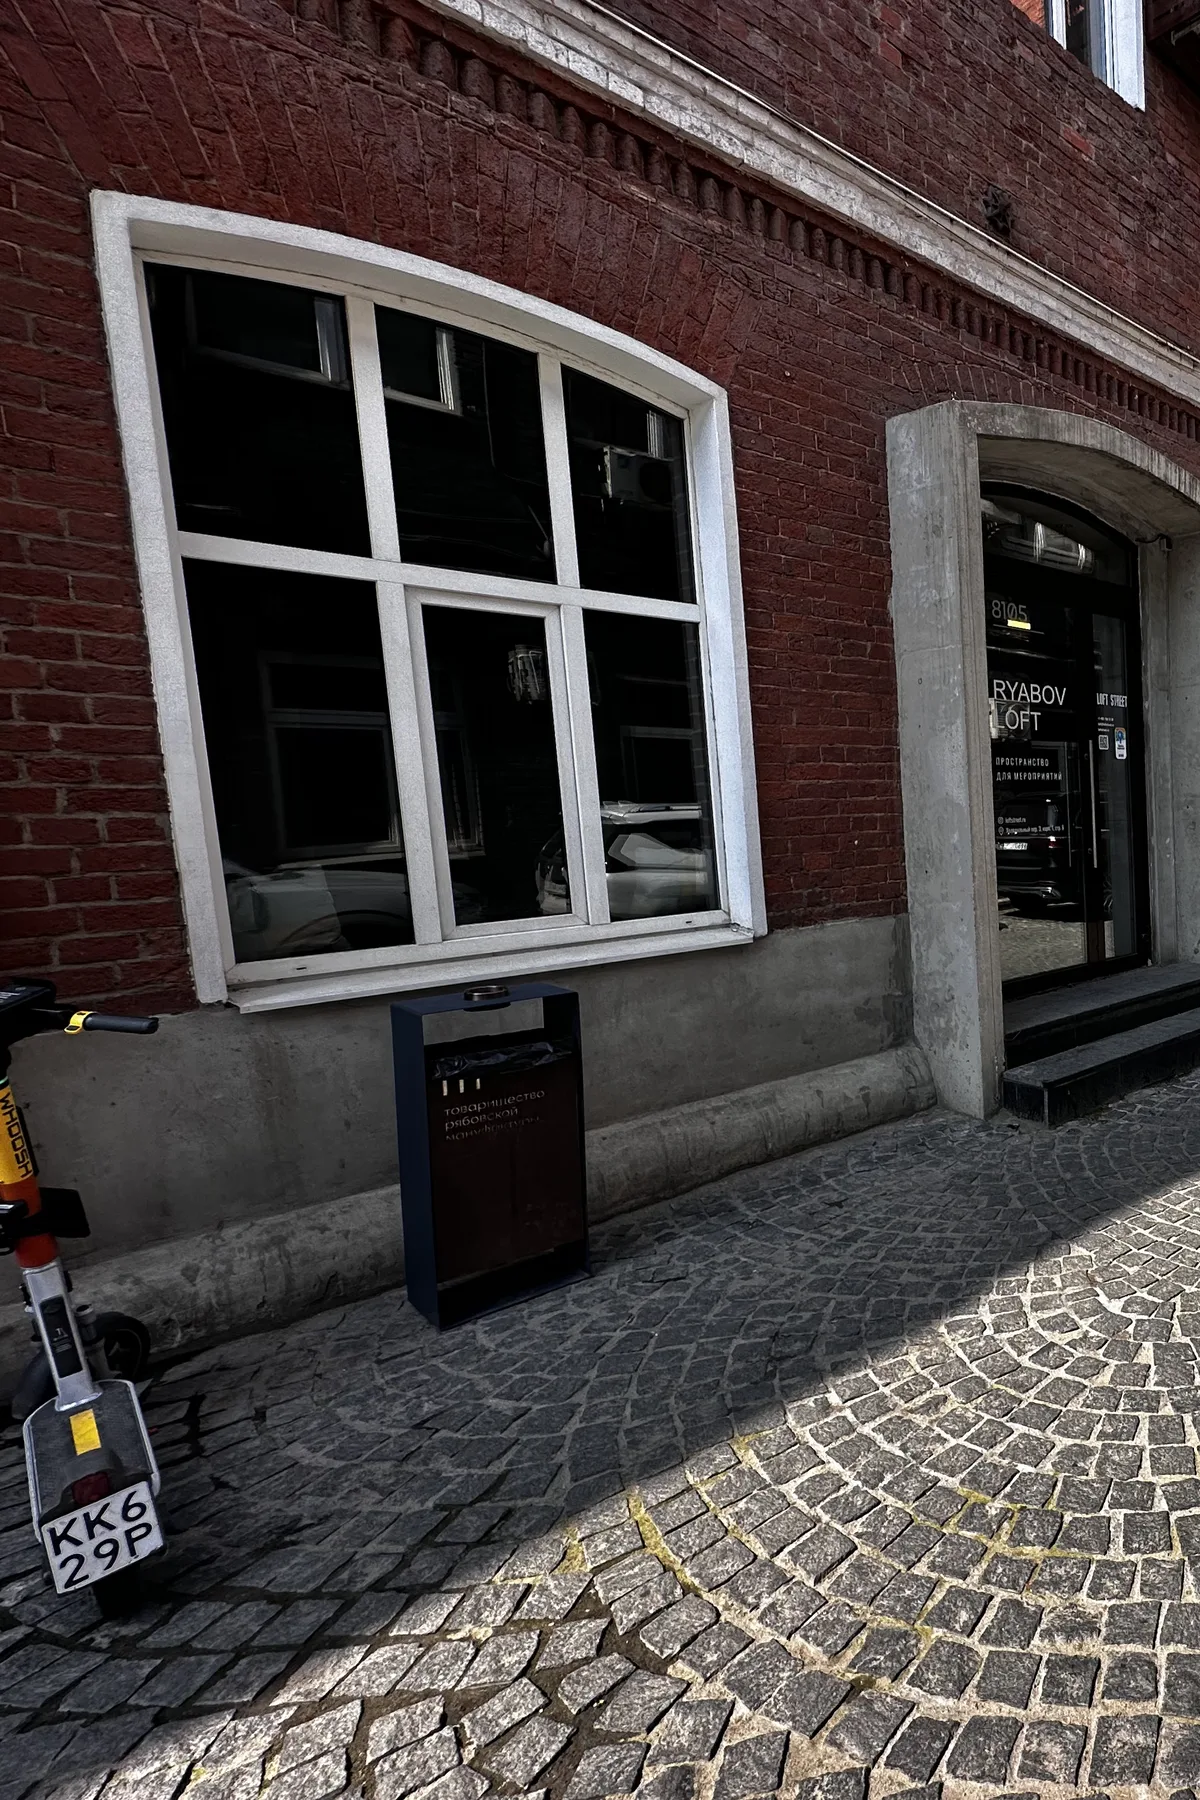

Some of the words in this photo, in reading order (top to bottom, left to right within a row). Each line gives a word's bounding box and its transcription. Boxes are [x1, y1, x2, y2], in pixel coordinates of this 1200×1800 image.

[993, 679, 1067, 706] RYABOV
[1096, 692, 1109, 706] LOFT
[1110, 694, 1128, 707] STREET
[995, 707, 1042, 731] LOFT
[995, 757, 1050, 767] ПРОСТРАНСТВО
[996, 771, 1012, 781] ДЛЯ
[1013, 771, 1063, 781] МЕРОПРИЯТИЙ
[444, 1090, 546, 1116] товарищество
[445, 1106, 518, 1132] рябовской
[0, 1092, 33, 1178] WHOOSH
